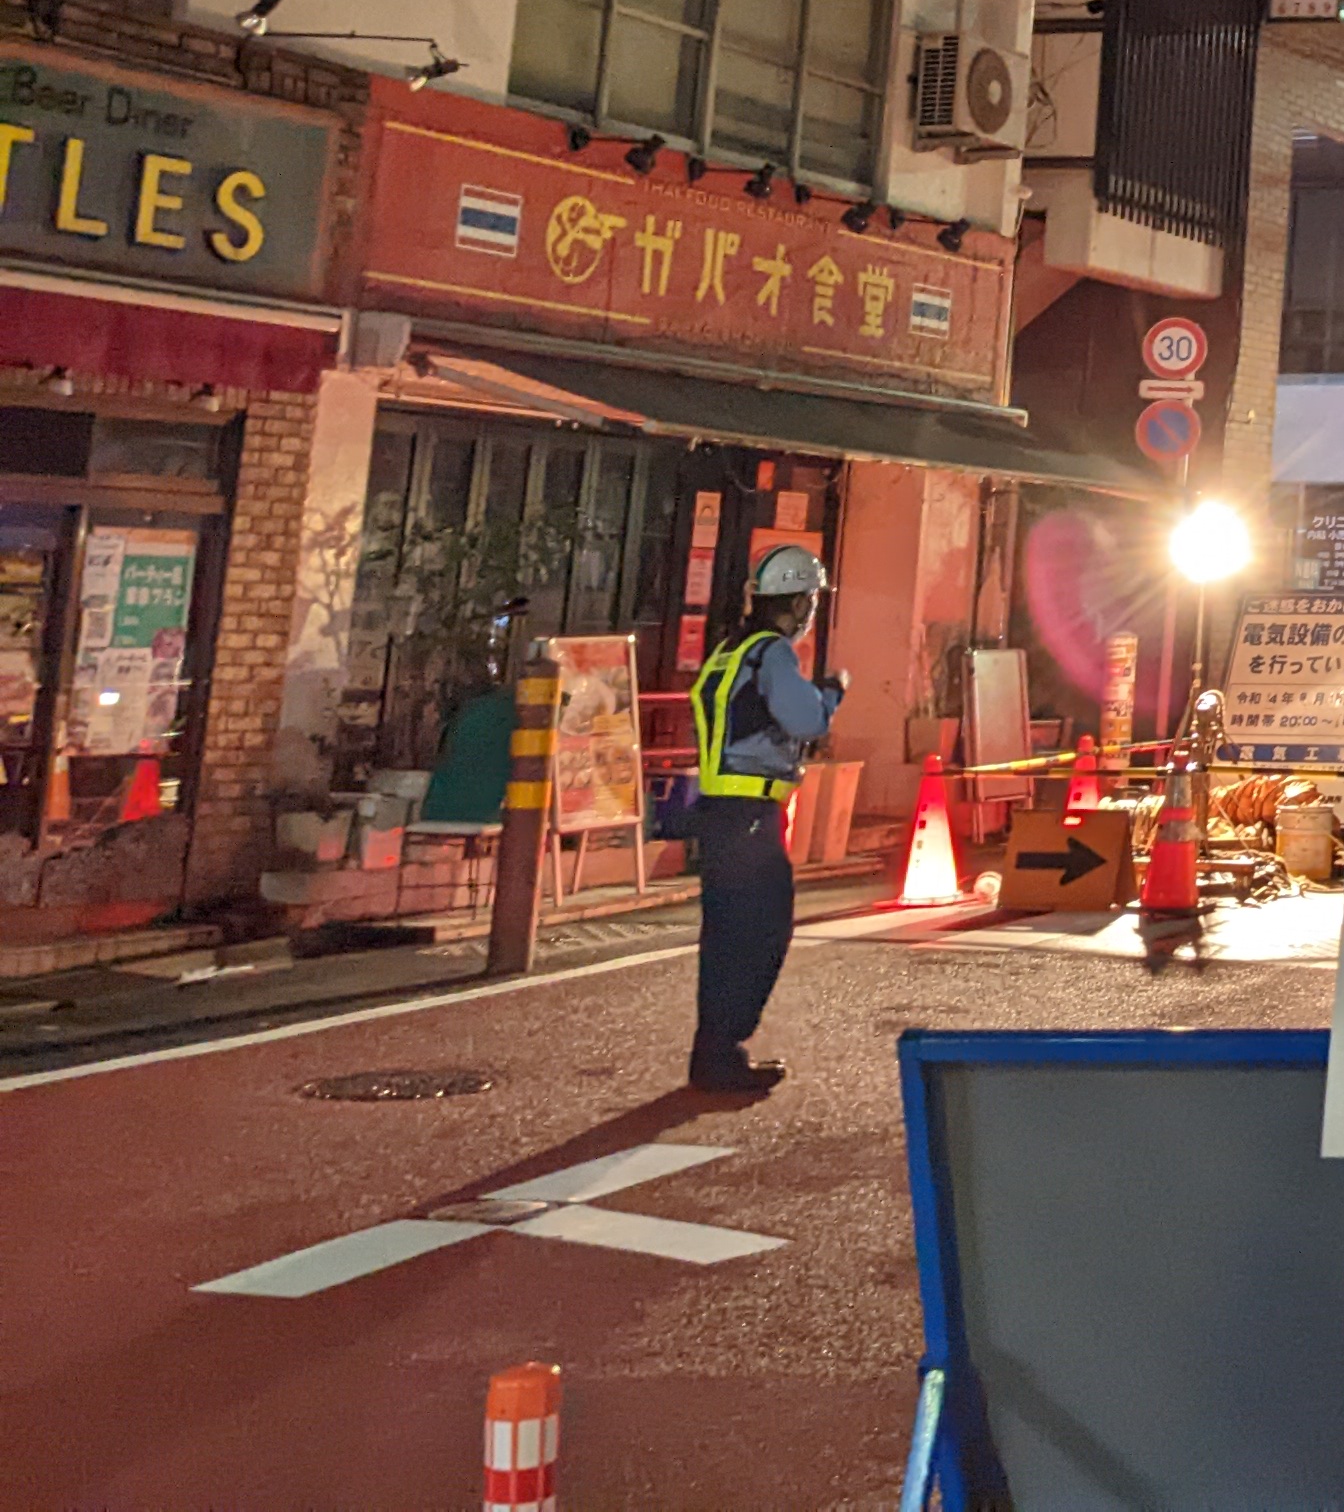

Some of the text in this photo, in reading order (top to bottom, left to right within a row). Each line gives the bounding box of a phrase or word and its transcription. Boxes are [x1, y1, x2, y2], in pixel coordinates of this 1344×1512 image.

[633, 214, 895, 339] ガパオ食堂
[1158, 335, 1193, 361] 30
